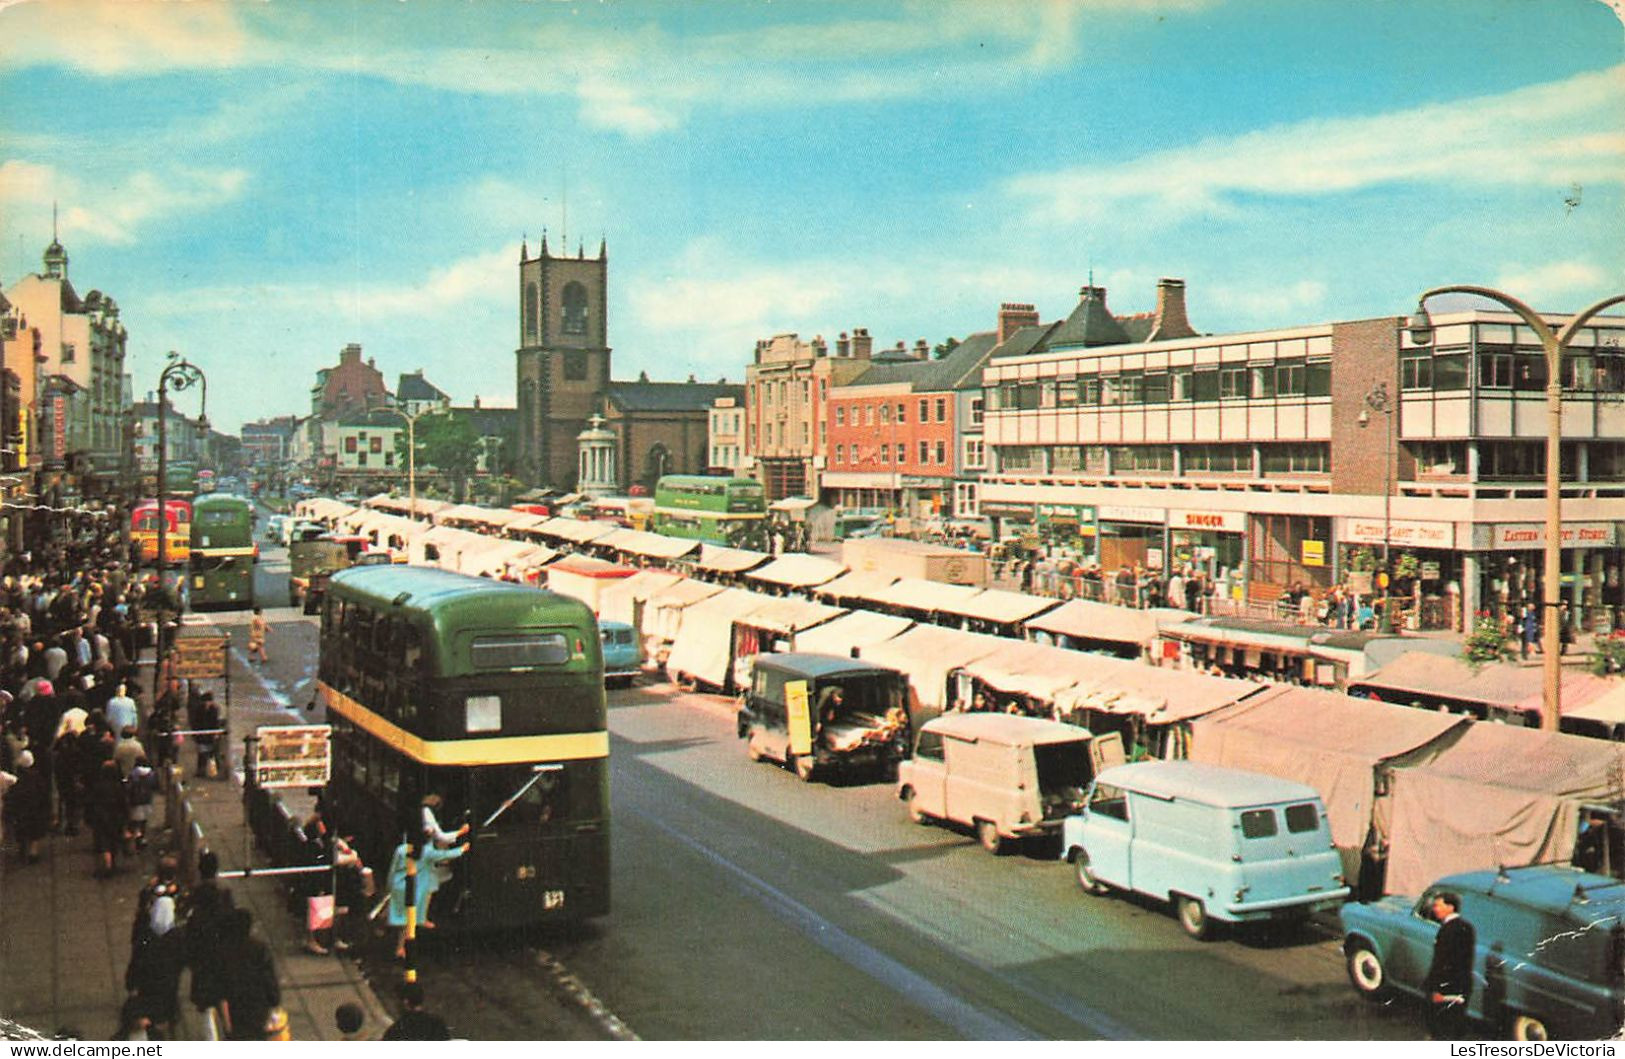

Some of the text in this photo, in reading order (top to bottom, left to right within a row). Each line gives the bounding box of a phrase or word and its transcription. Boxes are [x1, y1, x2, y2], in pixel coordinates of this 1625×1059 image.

[1186, 514, 1224, 527] SINGER
[1504, 530, 1538, 541] EASTERN
[1578, 528, 1608, 540] STORES
